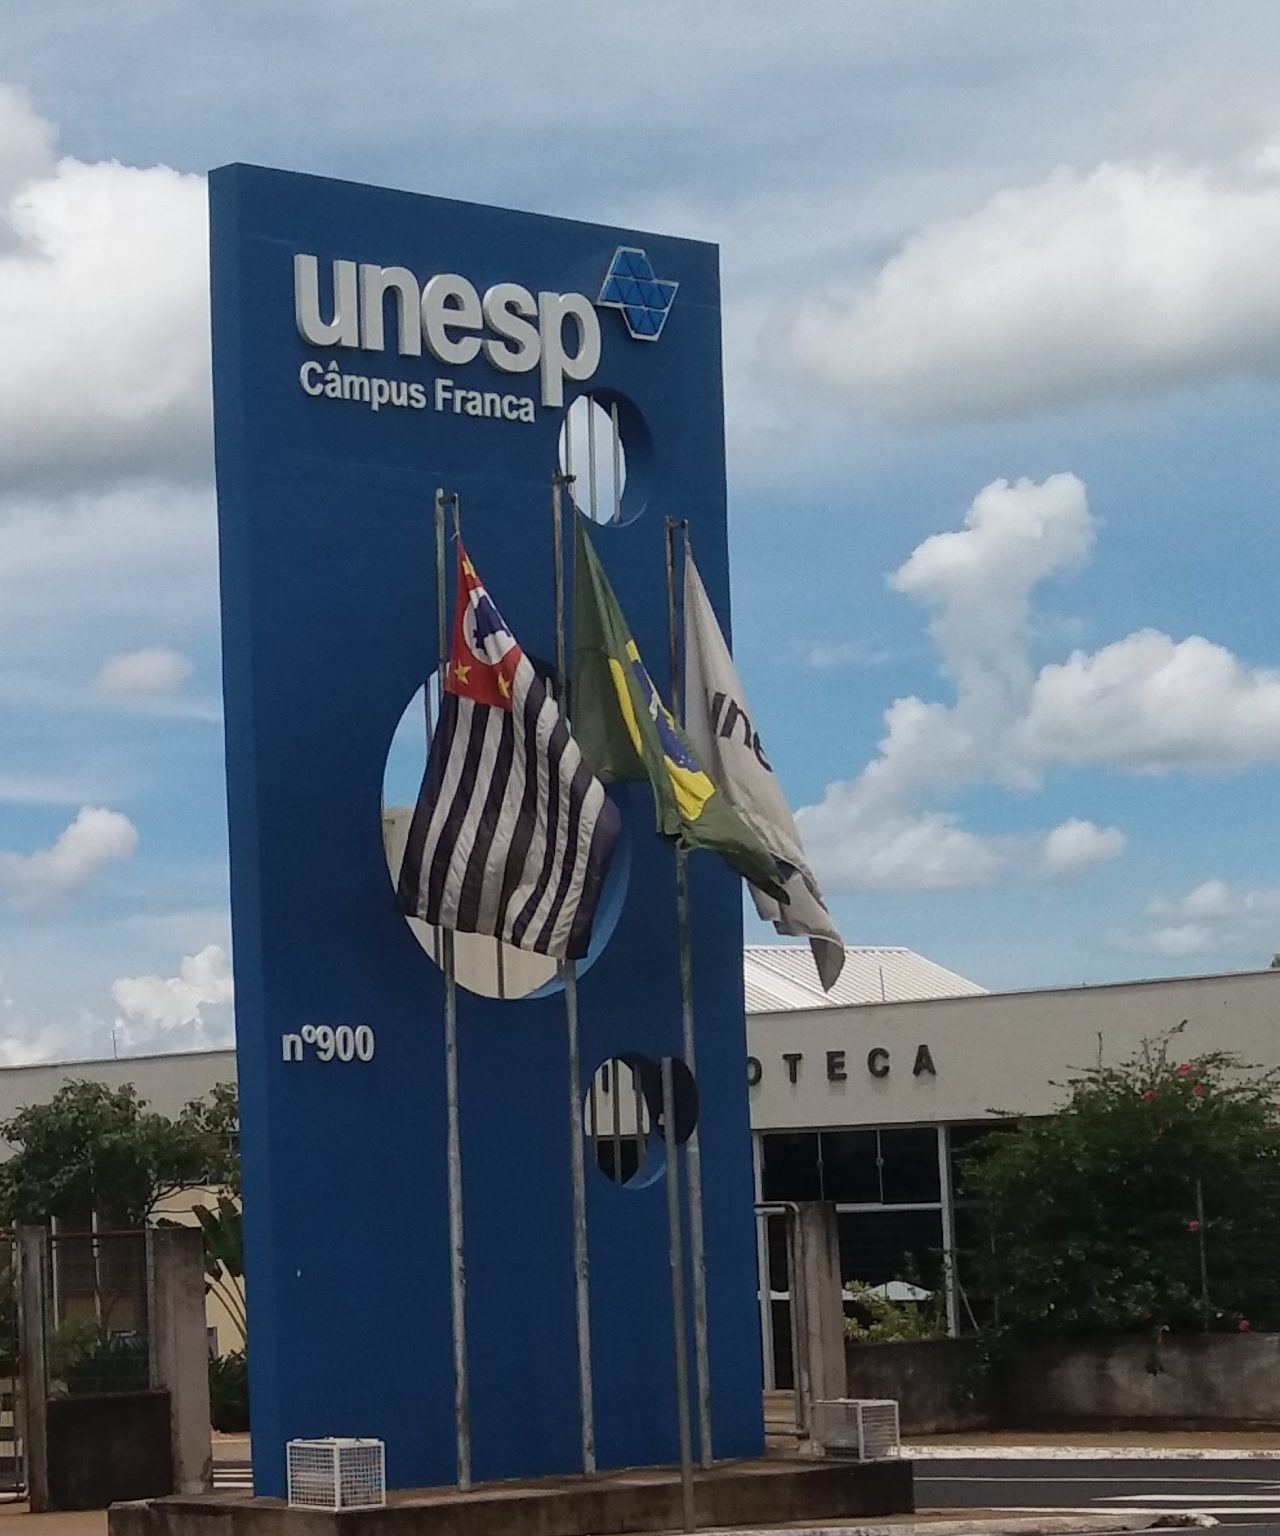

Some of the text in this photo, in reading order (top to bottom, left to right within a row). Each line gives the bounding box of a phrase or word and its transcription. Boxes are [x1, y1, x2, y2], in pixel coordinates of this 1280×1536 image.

[294, 253, 602, 408] unesp
[299, 360, 536, 424] Câmpus Franca
